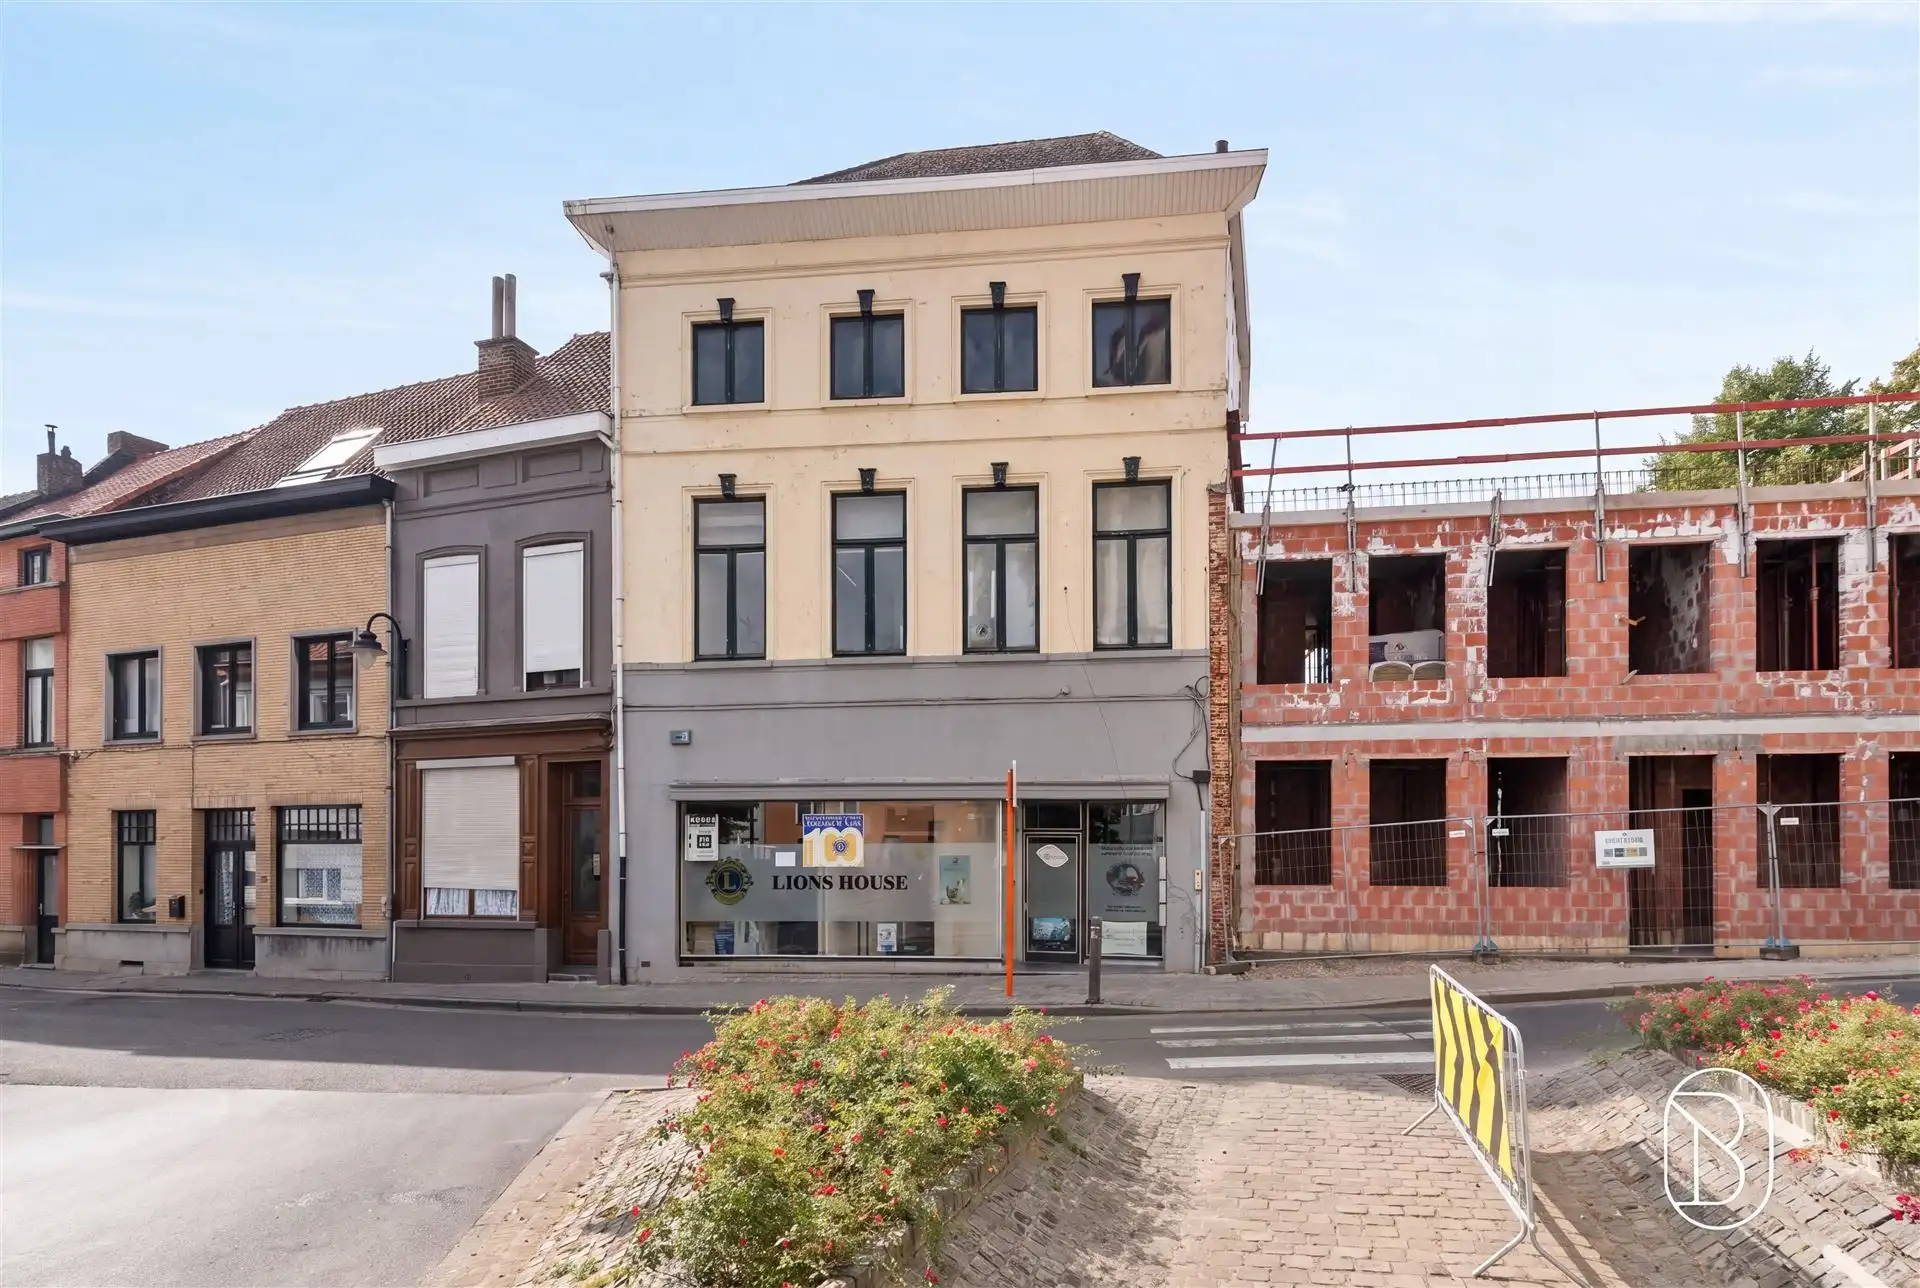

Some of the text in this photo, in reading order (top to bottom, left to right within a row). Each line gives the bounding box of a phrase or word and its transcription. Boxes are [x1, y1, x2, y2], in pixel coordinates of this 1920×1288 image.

[722, 871, 737, 889] L
[771, 874, 908, 890] LIONS HOUSE
